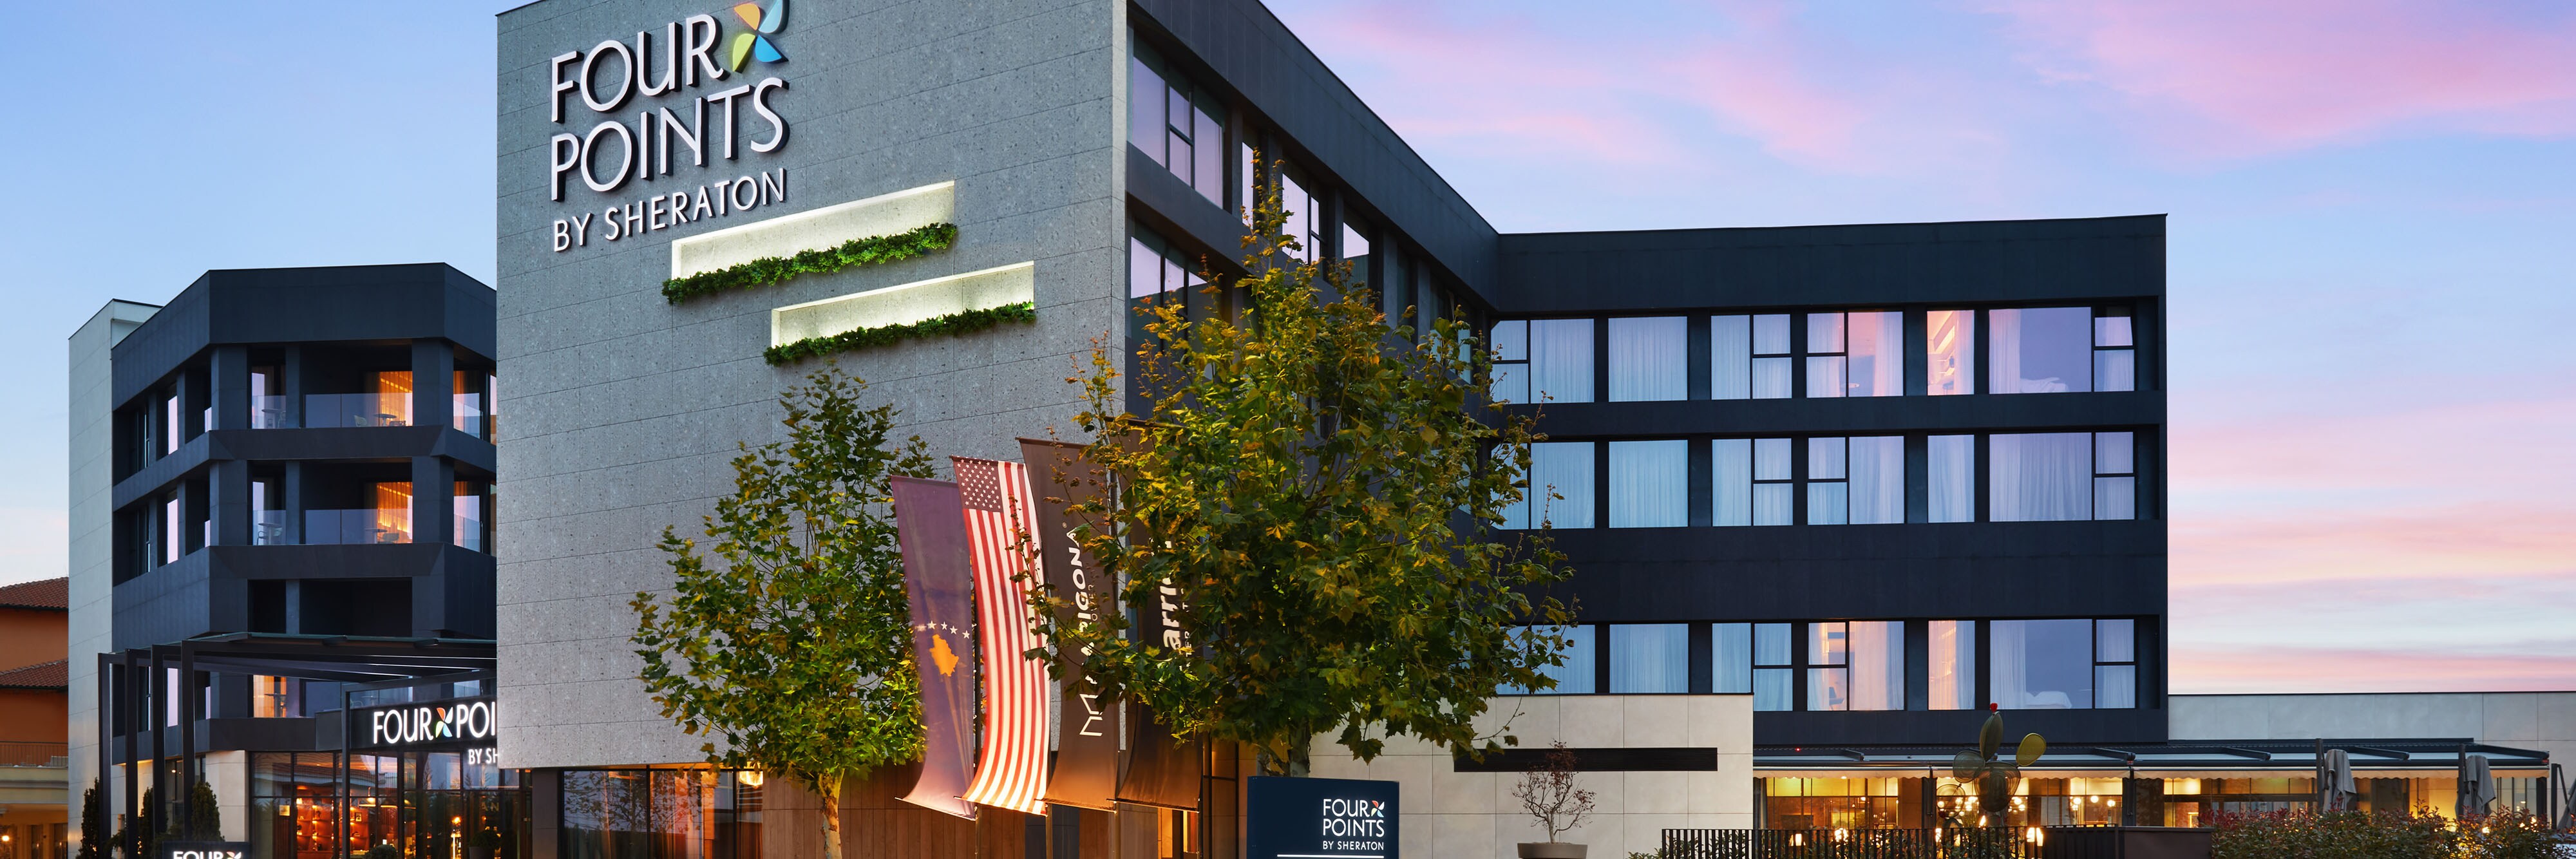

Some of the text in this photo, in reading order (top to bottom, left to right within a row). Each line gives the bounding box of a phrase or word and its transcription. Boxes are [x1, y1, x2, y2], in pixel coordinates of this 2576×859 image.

[552, 14, 726, 123] FOUR
[552, 77, 785, 202] POINTS
[554, 168, 786, 252] BY SHERATON
[374, 701, 496, 744] FOUR POI
[468, 749, 482, 764] BY
[1323, 798, 1370, 818] FOUR
[1323, 818, 1385, 838] POINTS
[1323, 840, 1384, 851] BY SHERATON
